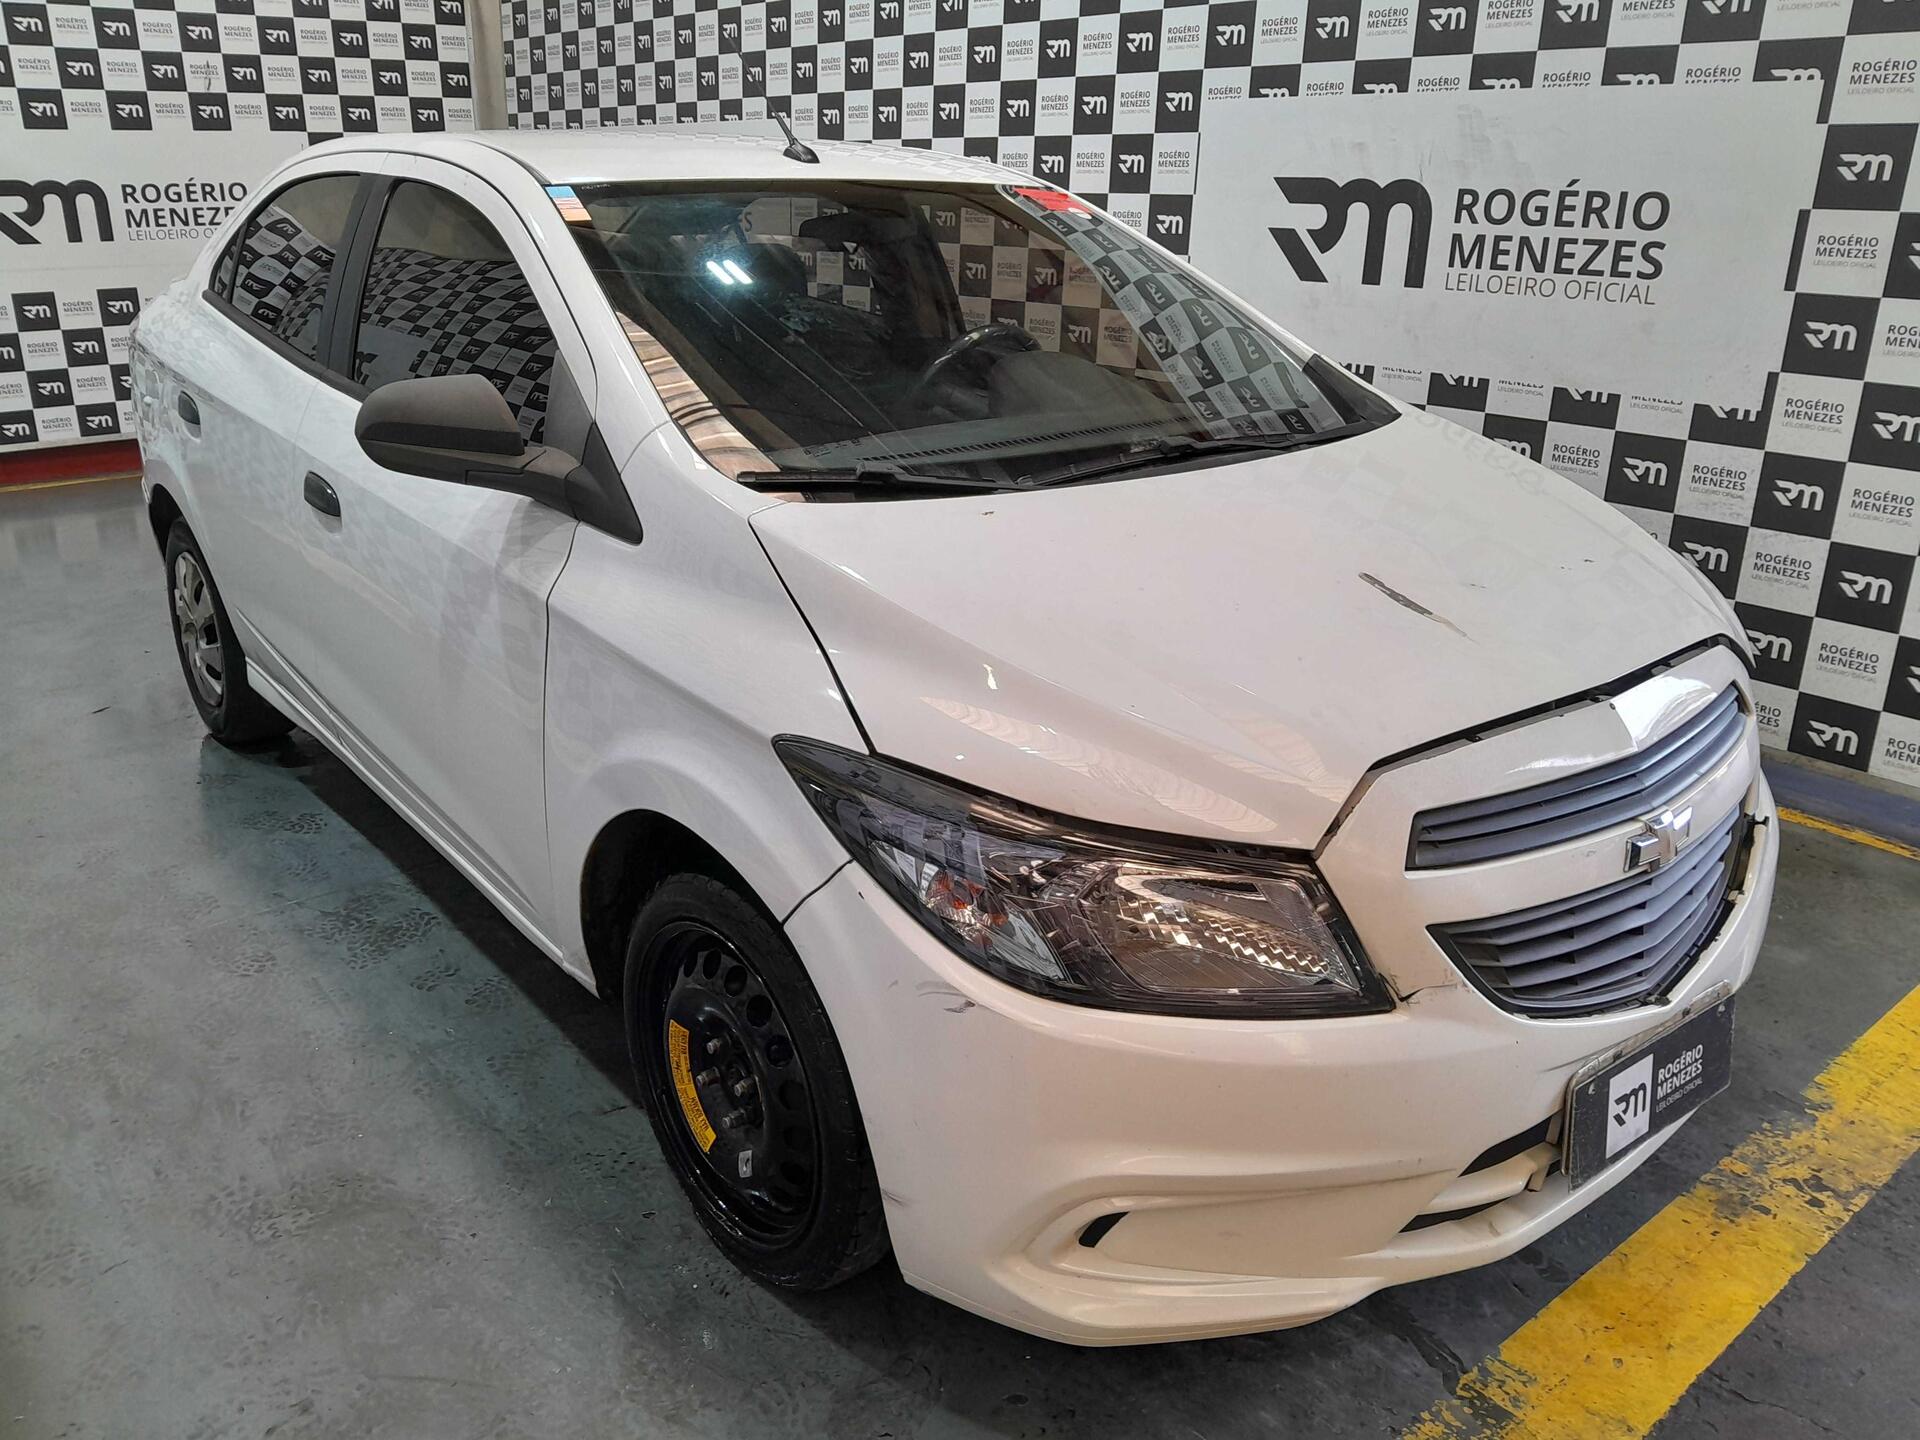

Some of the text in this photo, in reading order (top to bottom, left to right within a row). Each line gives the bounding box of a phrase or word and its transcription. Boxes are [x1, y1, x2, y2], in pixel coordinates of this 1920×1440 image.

[1622, 0, 1675, 12] MENEZES
[1368, 7, 1408, 19] ROGÉRIO
[1487, 8, 1533, 20] MENEZES
[1262, 16, 1298, 27] ROGÉRIO
[1367, 18, 1407, 28] MENEZES
[1168, 25, 1200, 34] ROGÉRIO
[1261, 26, 1297, 36] MENEZES
[1083, 32, 1112, 41] ROGÉRIO
[1167, 34, 1199, 43] MENEZES
[939, 45, 962, 53] ROGÉRIO
[1007, 39, 1033, 47] ROGÉRIO
[1083, 41, 1112, 50] MENEZES
[939, 53, 962, 61] MENEZES
[1007, 47, 1033, 55] MENEZES
[1852, 59, 1917, 72] ROGÉRIO
[1542, 70, 1591, 83] ROGÉRIO
[1686, 66, 1742, 78] ROGÉRIO
[1417, 75, 1460, 88] ROGÉRIO
[1850, 72, 1915, 85] MENEZES
[1208, 86, 1242, 96] ROGÉRIO
[1306, 81, 1345, 92] ROGÉRIO
[1042, 94, 1069, 102] ROGÉRIO
[1121, 91, 1150, 99] ROGÉRIO
[970, 97, 994, 106] ROGÉRIO
[1041, 103, 1068, 111] MENEZES
[1120, 99, 1150, 107] MENEZES
[1003, 152, 1028, 160] ROGÉRIO
[1159, 150, 1190, 159] ROGÉRIO
[121, 177, 248, 204] ROGÉRIO
[1454, 179, 1670, 231] ROGÉRIO
[1112, 210, 1142, 219] ROGÉRIO
[128, 228, 199, 241] LEILOEIRO
[1817, 234, 1879, 247] ROGÉRIO
[1448, 233, 1666, 280] MENEZES
[1815, 247, 1877, 259] MENEZES
[1445, 272, 1656, 305] LEILOEIRO OFICIAL
[1786, 398, 1844, 413] ROGÉRIO
[1784, 409, 1843, 424] MENEZES
[1553, 444, 1600, 458] ROGÉRIO
[1552, 453, 1599, 468] MENEZES
[1693, 465, 1747, 480] ROGÉRIO
[1691, 475, 1745, 491] MENEZES
[1853, 489, 1914, 506] ROGÉRIO
[1851, 500, 1913, 517] MENEZES
[1756, 552, 1811, 570] ROGÉRIO
[1753, 562, 1810, 580] MENEZES
[1820, 643, 1879, 663] ROGÉRIO
[1818, 653, 1877, 674] MENEZES
[1658, 1044, 1703, 1083] ROGÉRIO
[1657, 1059, 1703, 1101] MENEZES
[1656, 1090, 1683, 1113] LEILOEIRO
